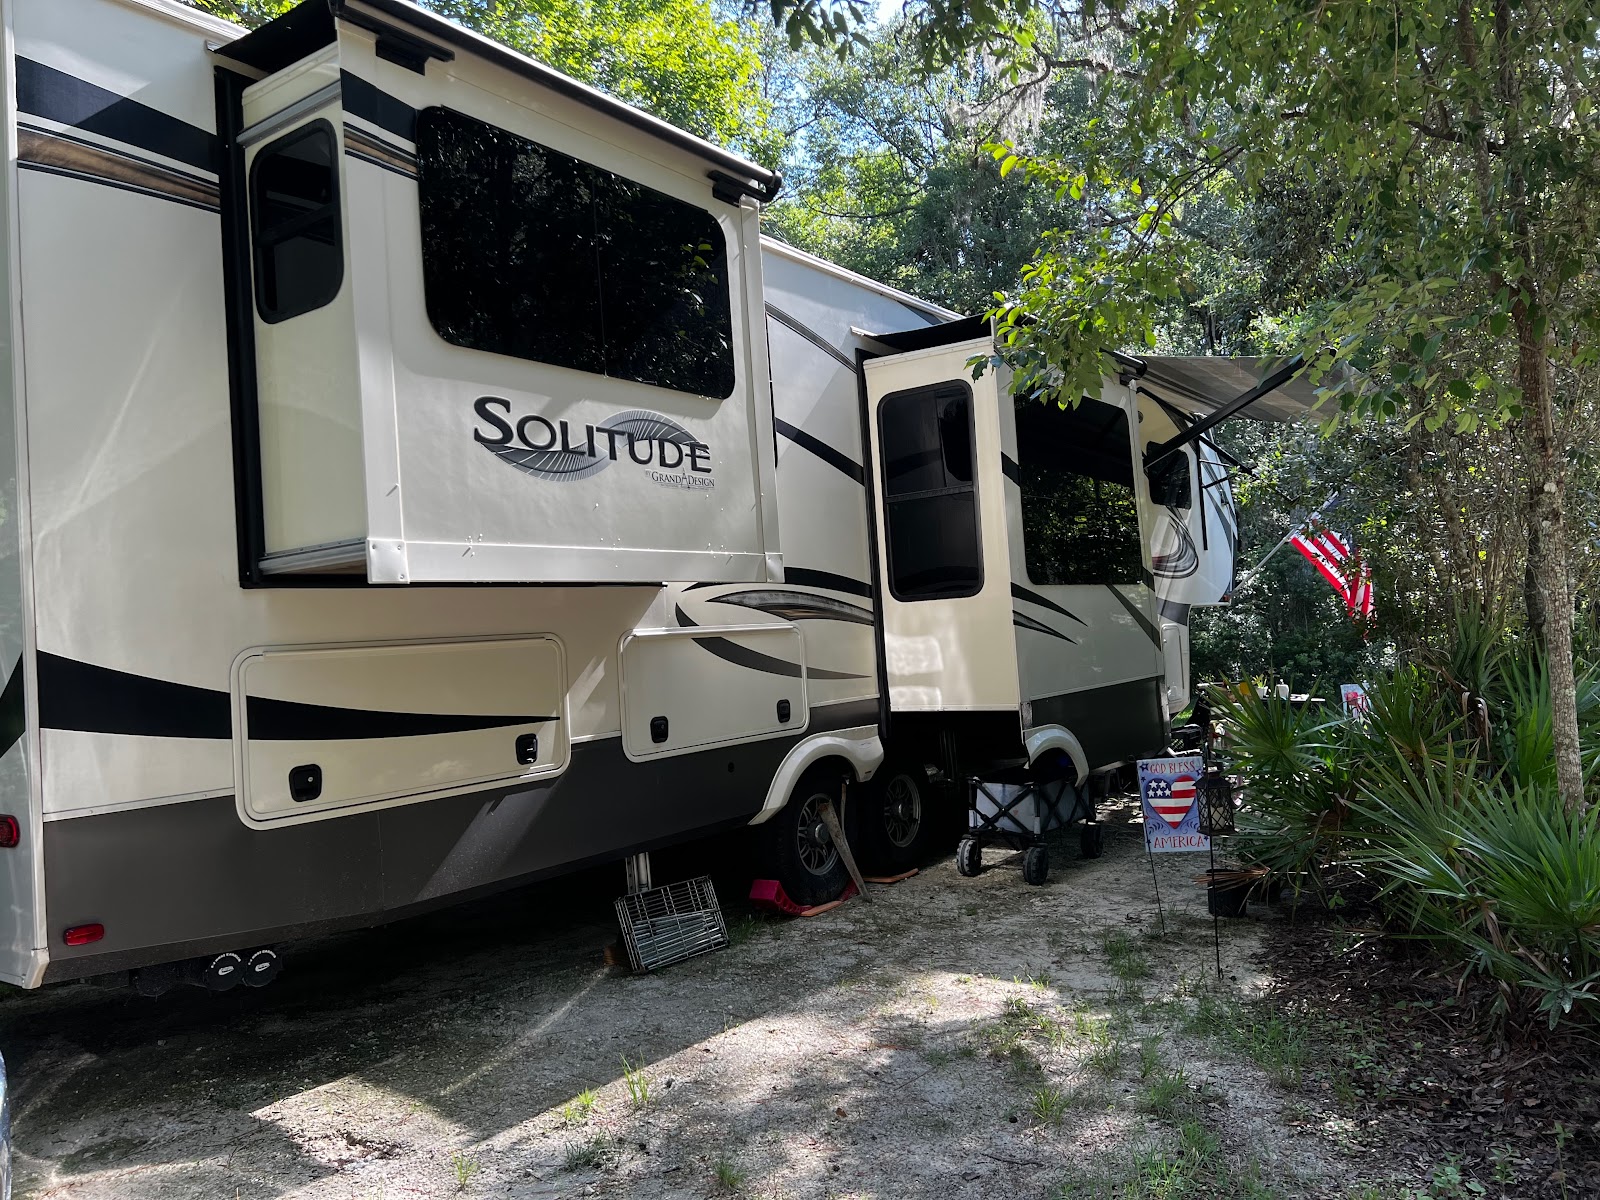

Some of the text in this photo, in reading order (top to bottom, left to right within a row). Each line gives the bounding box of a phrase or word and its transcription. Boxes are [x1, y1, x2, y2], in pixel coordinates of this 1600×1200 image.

[473, 395, 712, 474] SOLITUDE
[651, 471, 682, 484] GRAND
[688, 474, 715, 487] DESIGN
[1150, 762, 1195, 774] GOD BLESS
[1154, 836, 1205, 849] AMERICA
